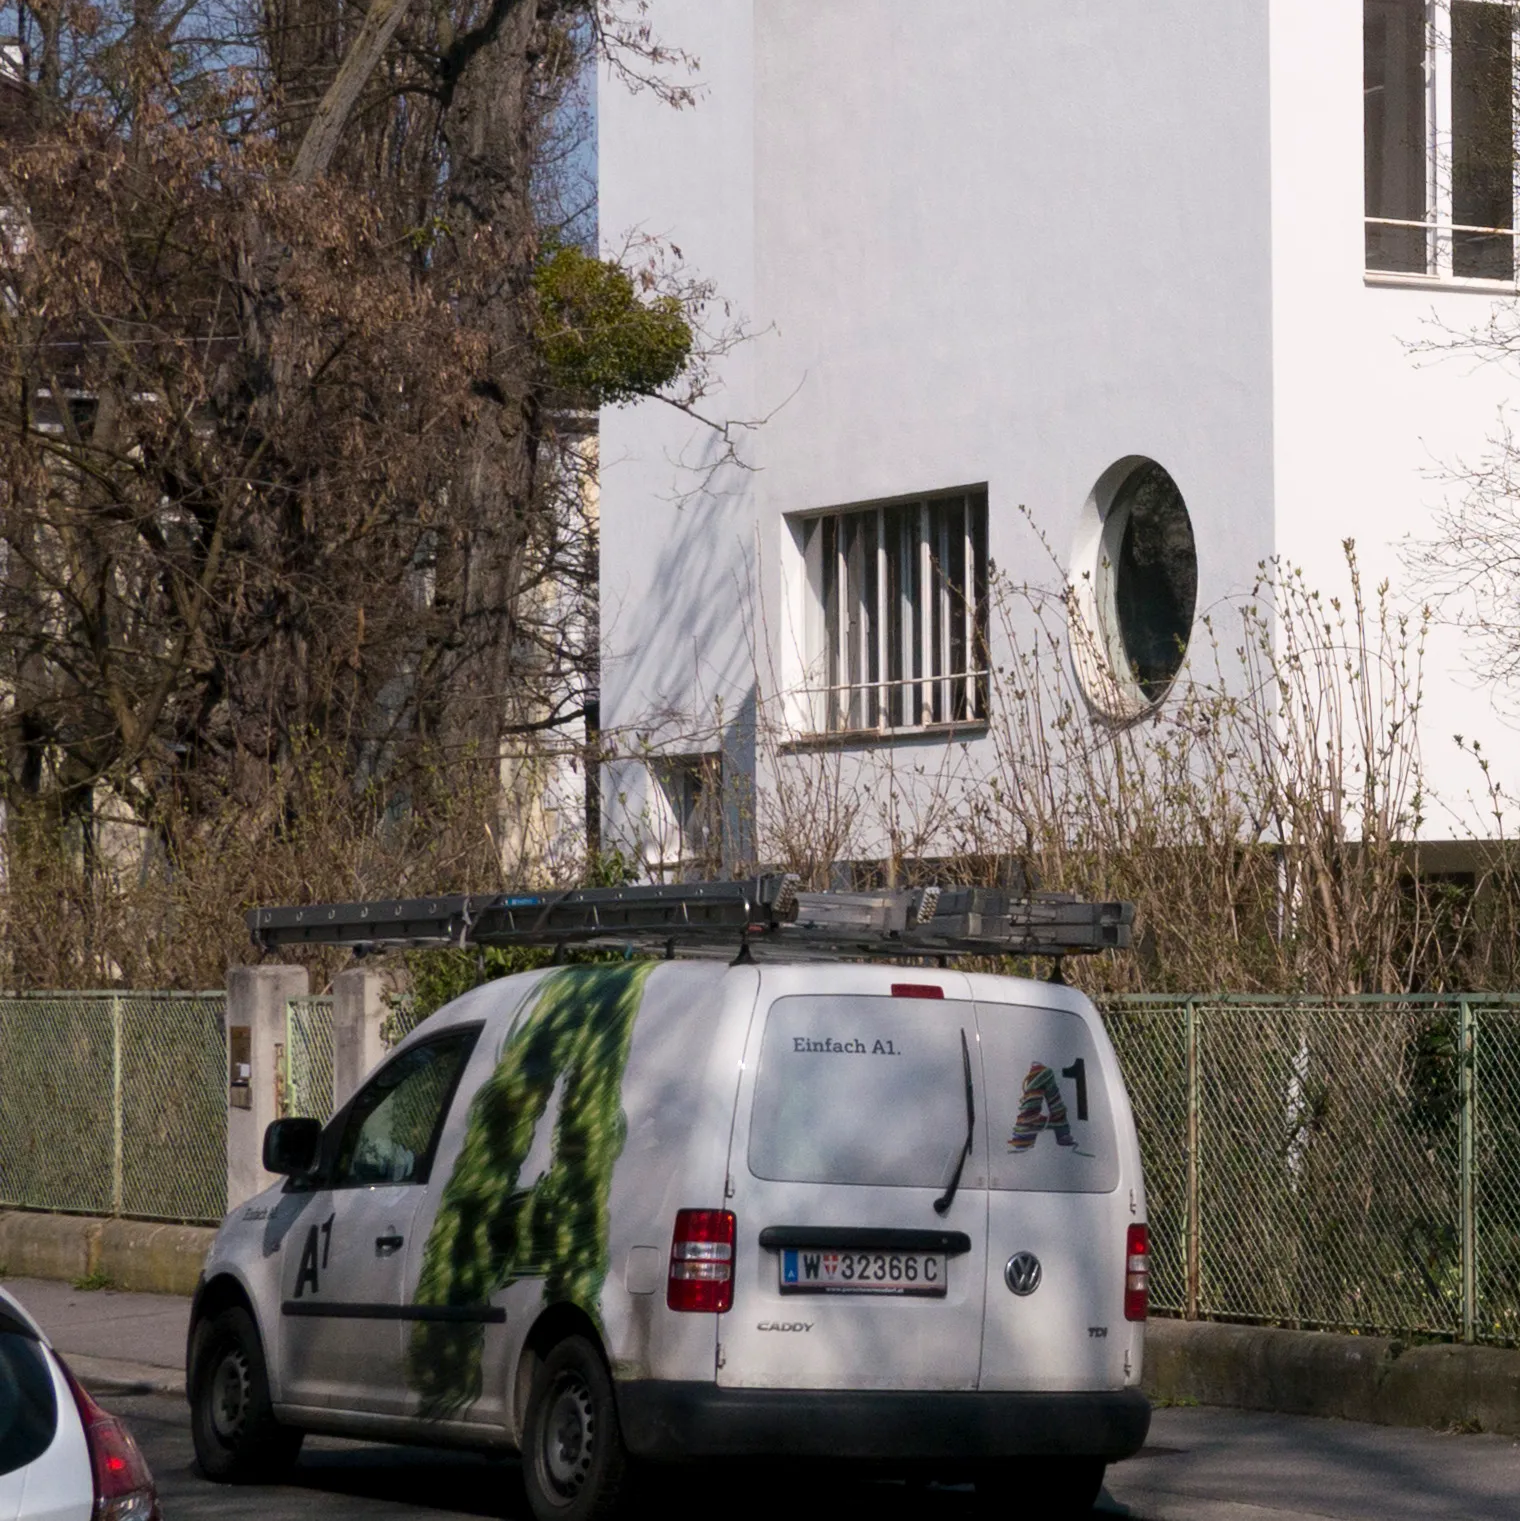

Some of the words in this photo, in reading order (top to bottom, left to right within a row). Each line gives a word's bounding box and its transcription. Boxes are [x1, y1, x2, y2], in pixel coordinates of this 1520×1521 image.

[792, 1036, 867, 1054] Einfach
[872, 1039, 901, 1055] A1.
[294, 1212, 336, 1298] A1
[804, 1254, 820, 1279] W
[841, 1254, 918, 1281] 32366
[924, 1257, 938, 1281] C
[757, 1321, 816, 1333] CADDY
[1088, 1327, 1108, 1338] TDI
